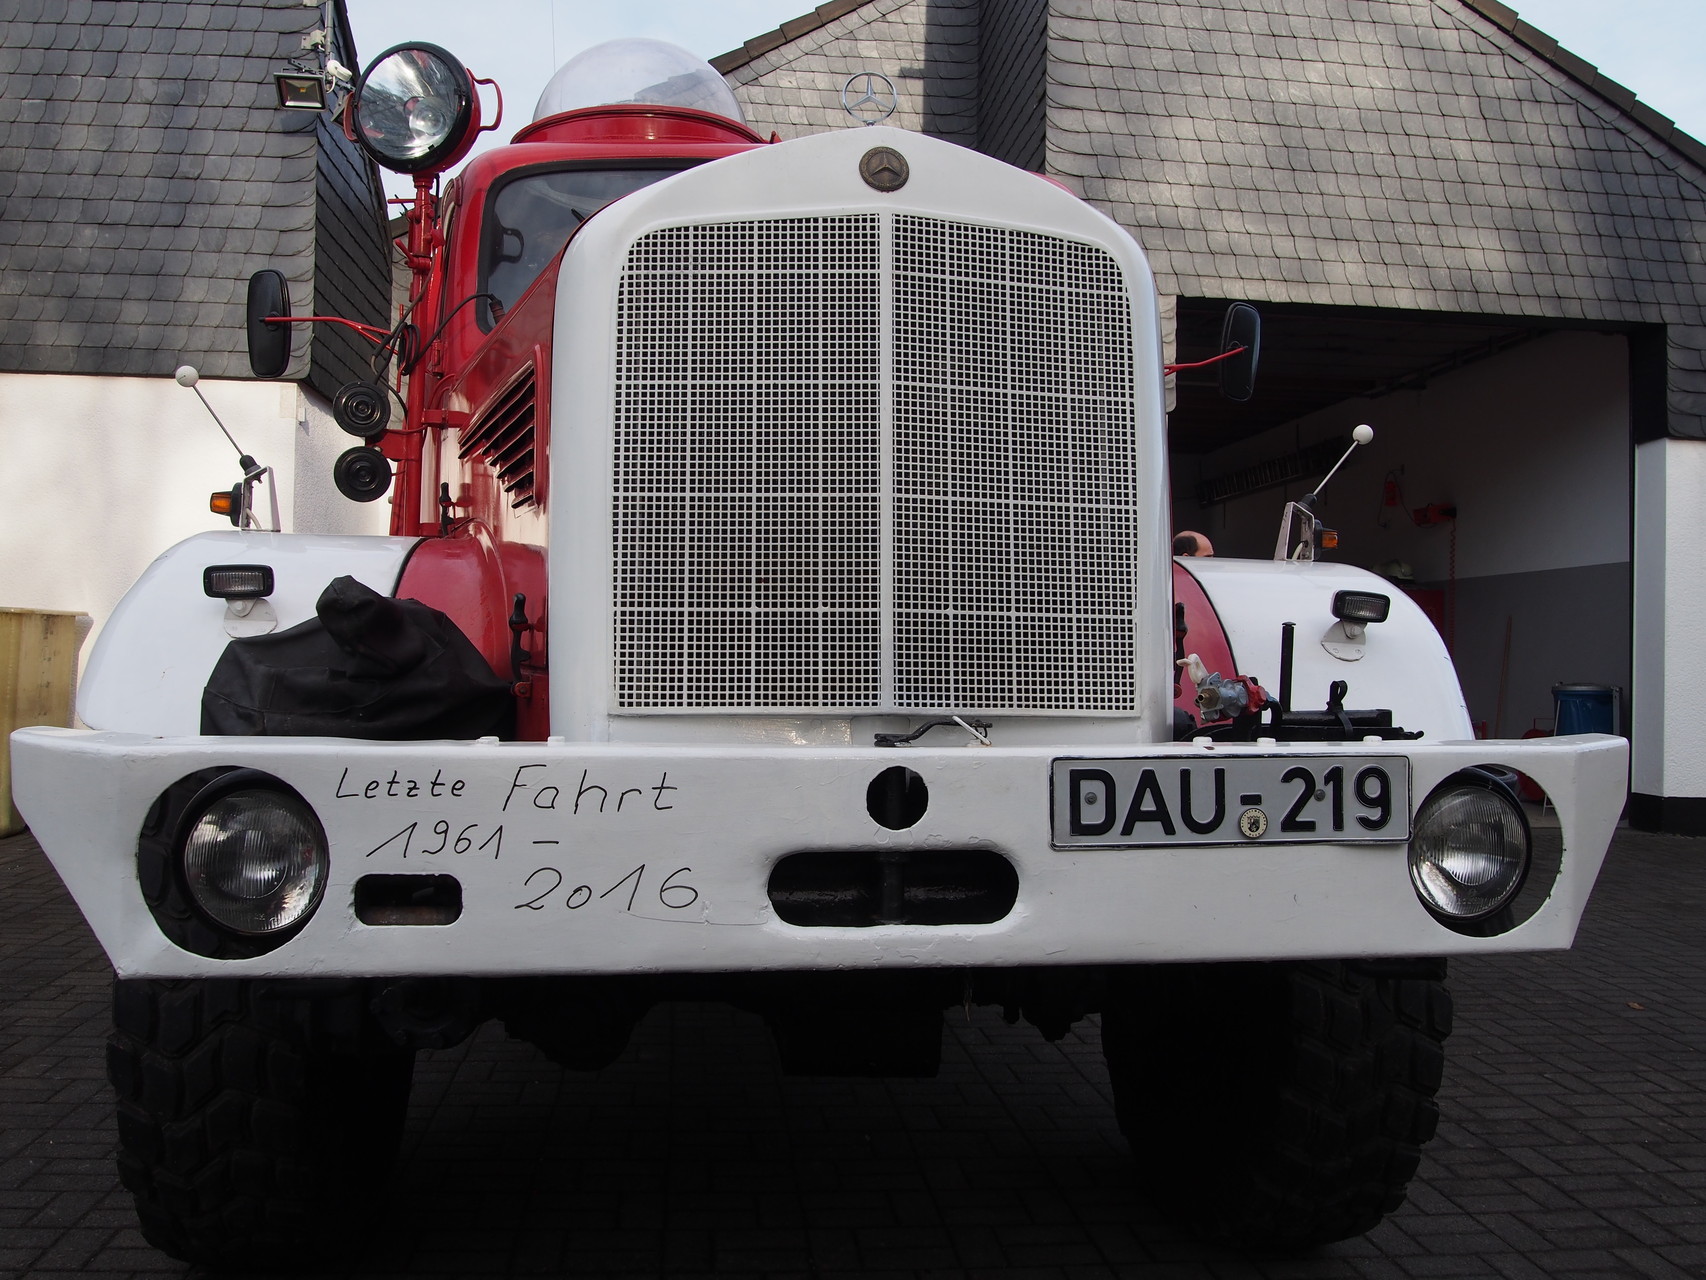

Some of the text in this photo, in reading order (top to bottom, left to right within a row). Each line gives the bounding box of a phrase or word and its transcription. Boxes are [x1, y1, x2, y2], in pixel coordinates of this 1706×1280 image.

[336, 764, 678, 815] Letzte Fahrt
[1069, 765, 1392, 836] DAU-219
[514, 864, 698, 911] 2016
